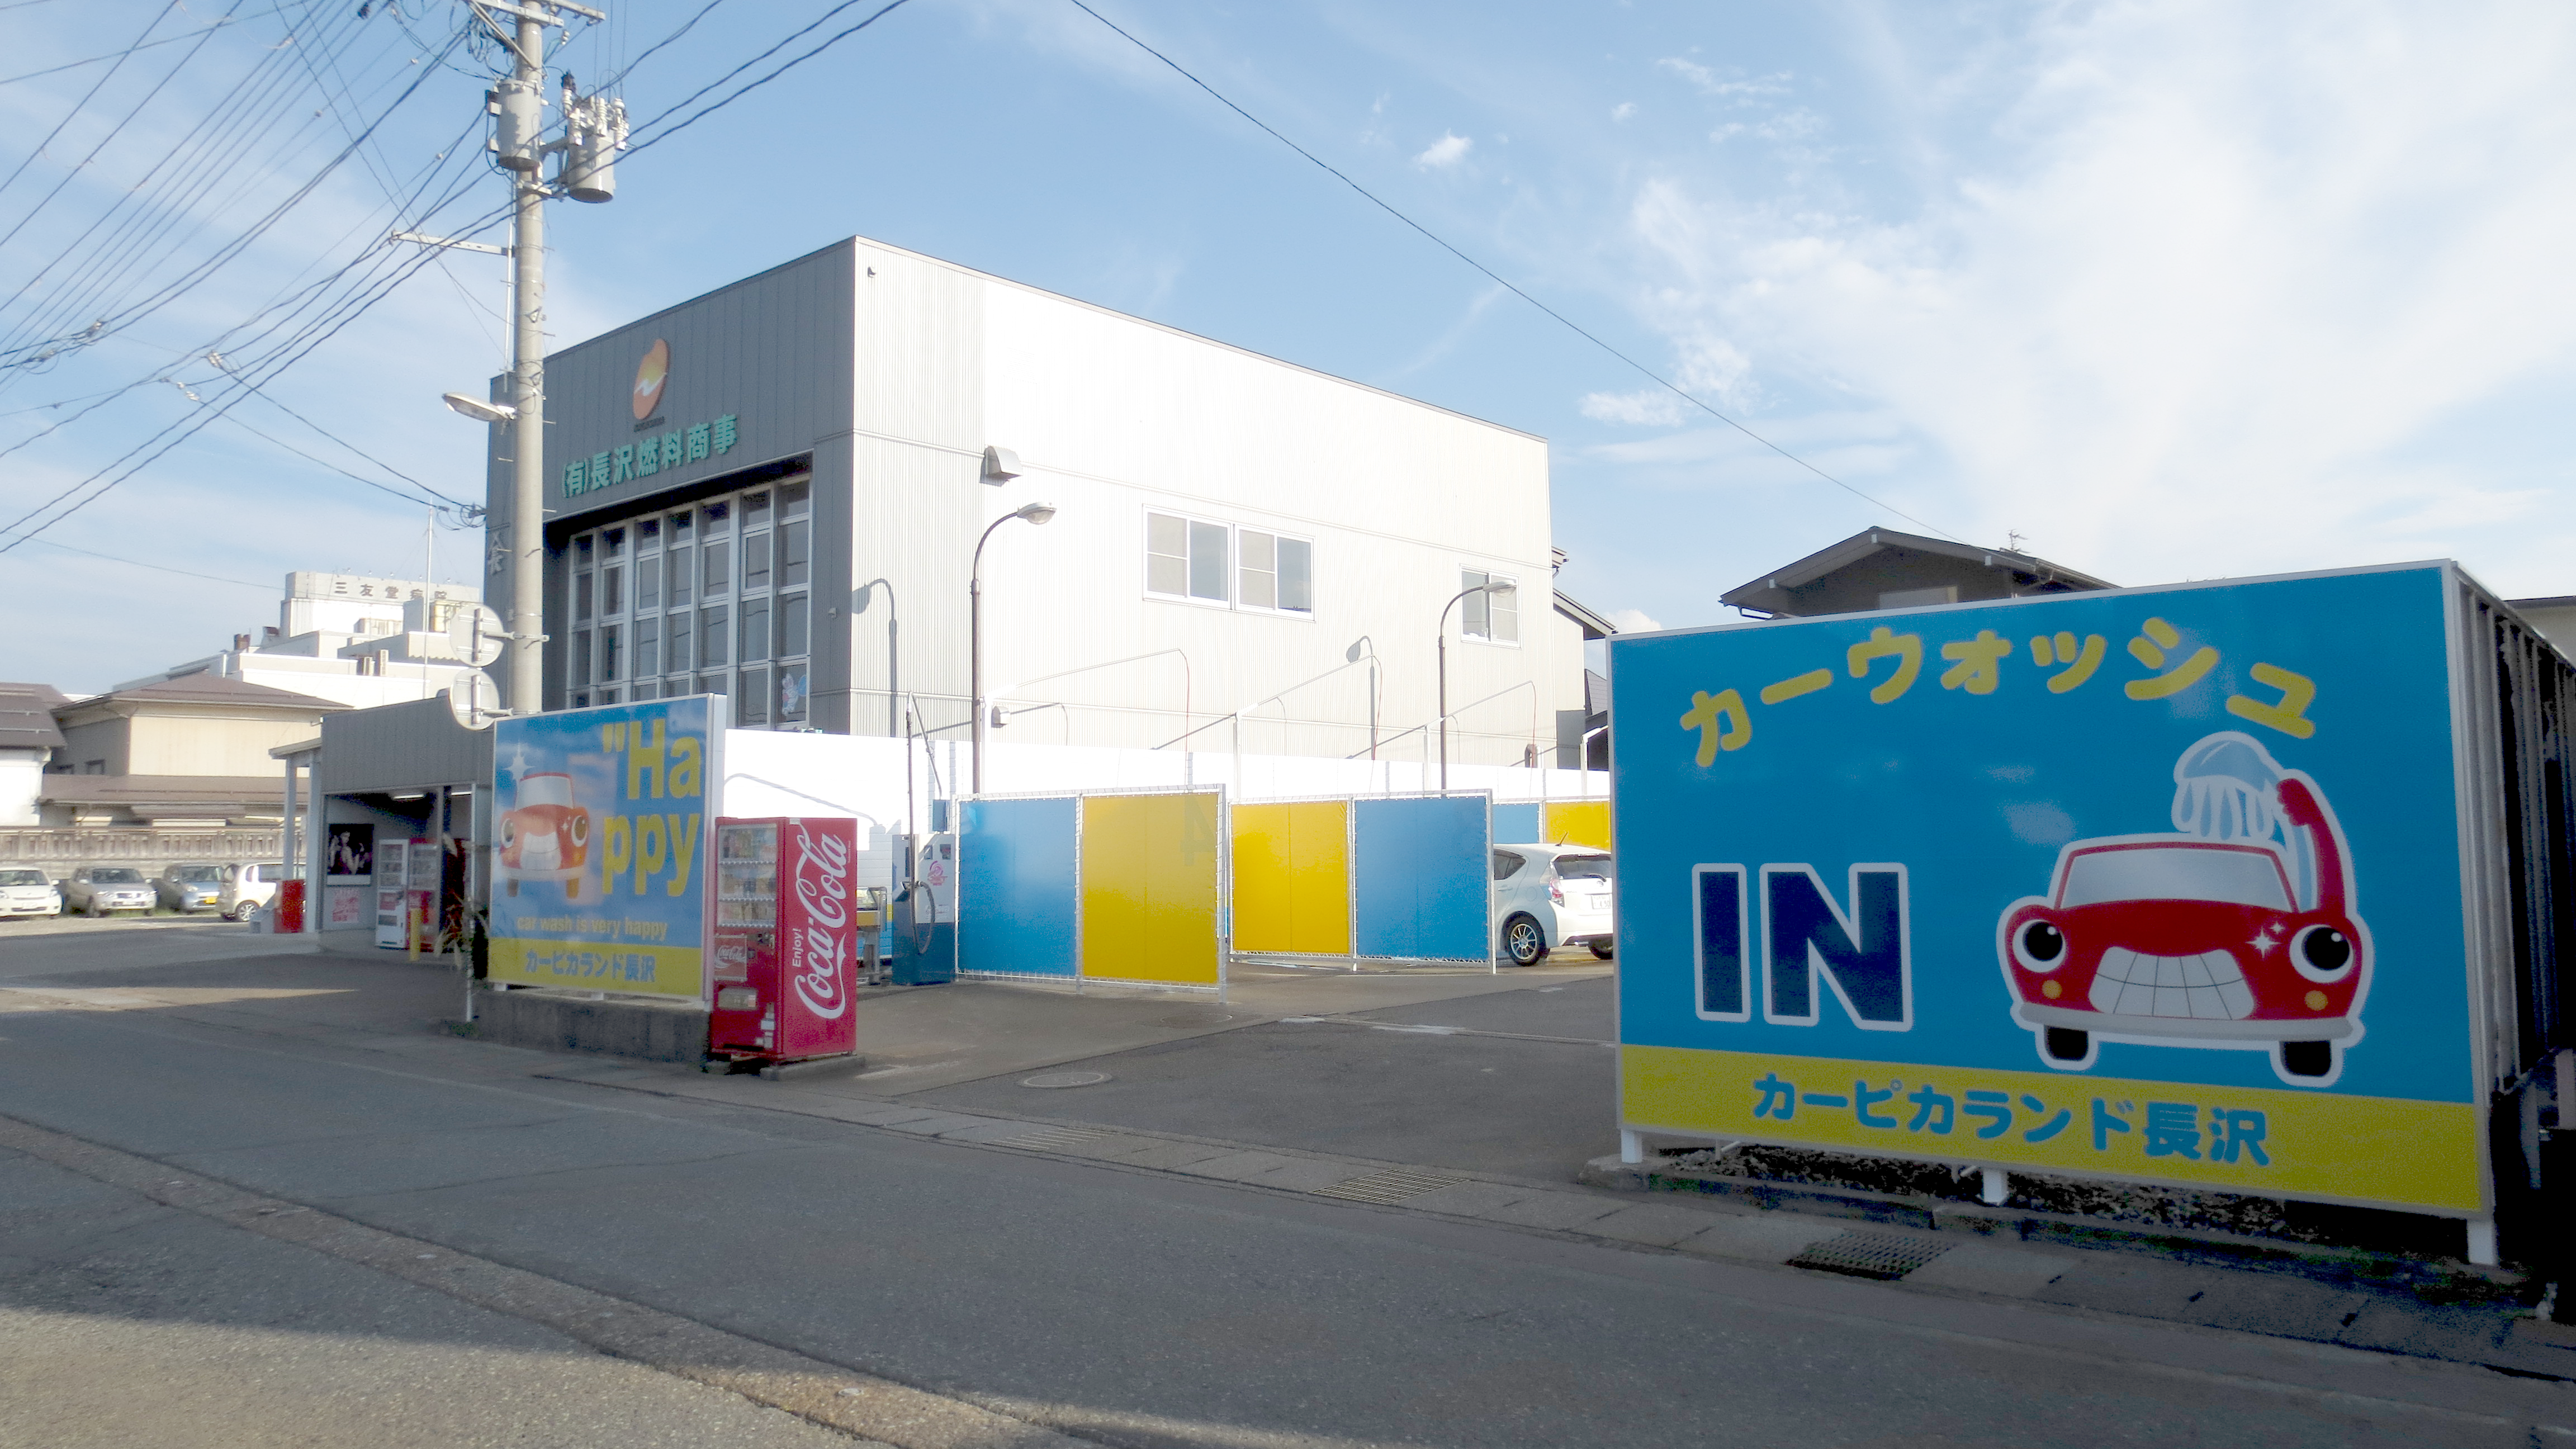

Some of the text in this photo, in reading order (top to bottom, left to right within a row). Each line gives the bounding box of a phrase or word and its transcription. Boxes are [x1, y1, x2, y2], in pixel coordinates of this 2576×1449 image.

[561, 413, 738, 498] (有)長沢燃料商事
[1680, 617, 2316, 768] カーウォッシュ
[602, 813, 701, 897] ppy
[517, 915, 667, 941] car wash is very happy
[792, 928, 804, 968] Enjoy!
[794, 823, 850, 1019] Coca-Cola
[1692, 862, 1913, 1033] IN
[1753, 1073, 2271, 1167] カーピカランド長沢
